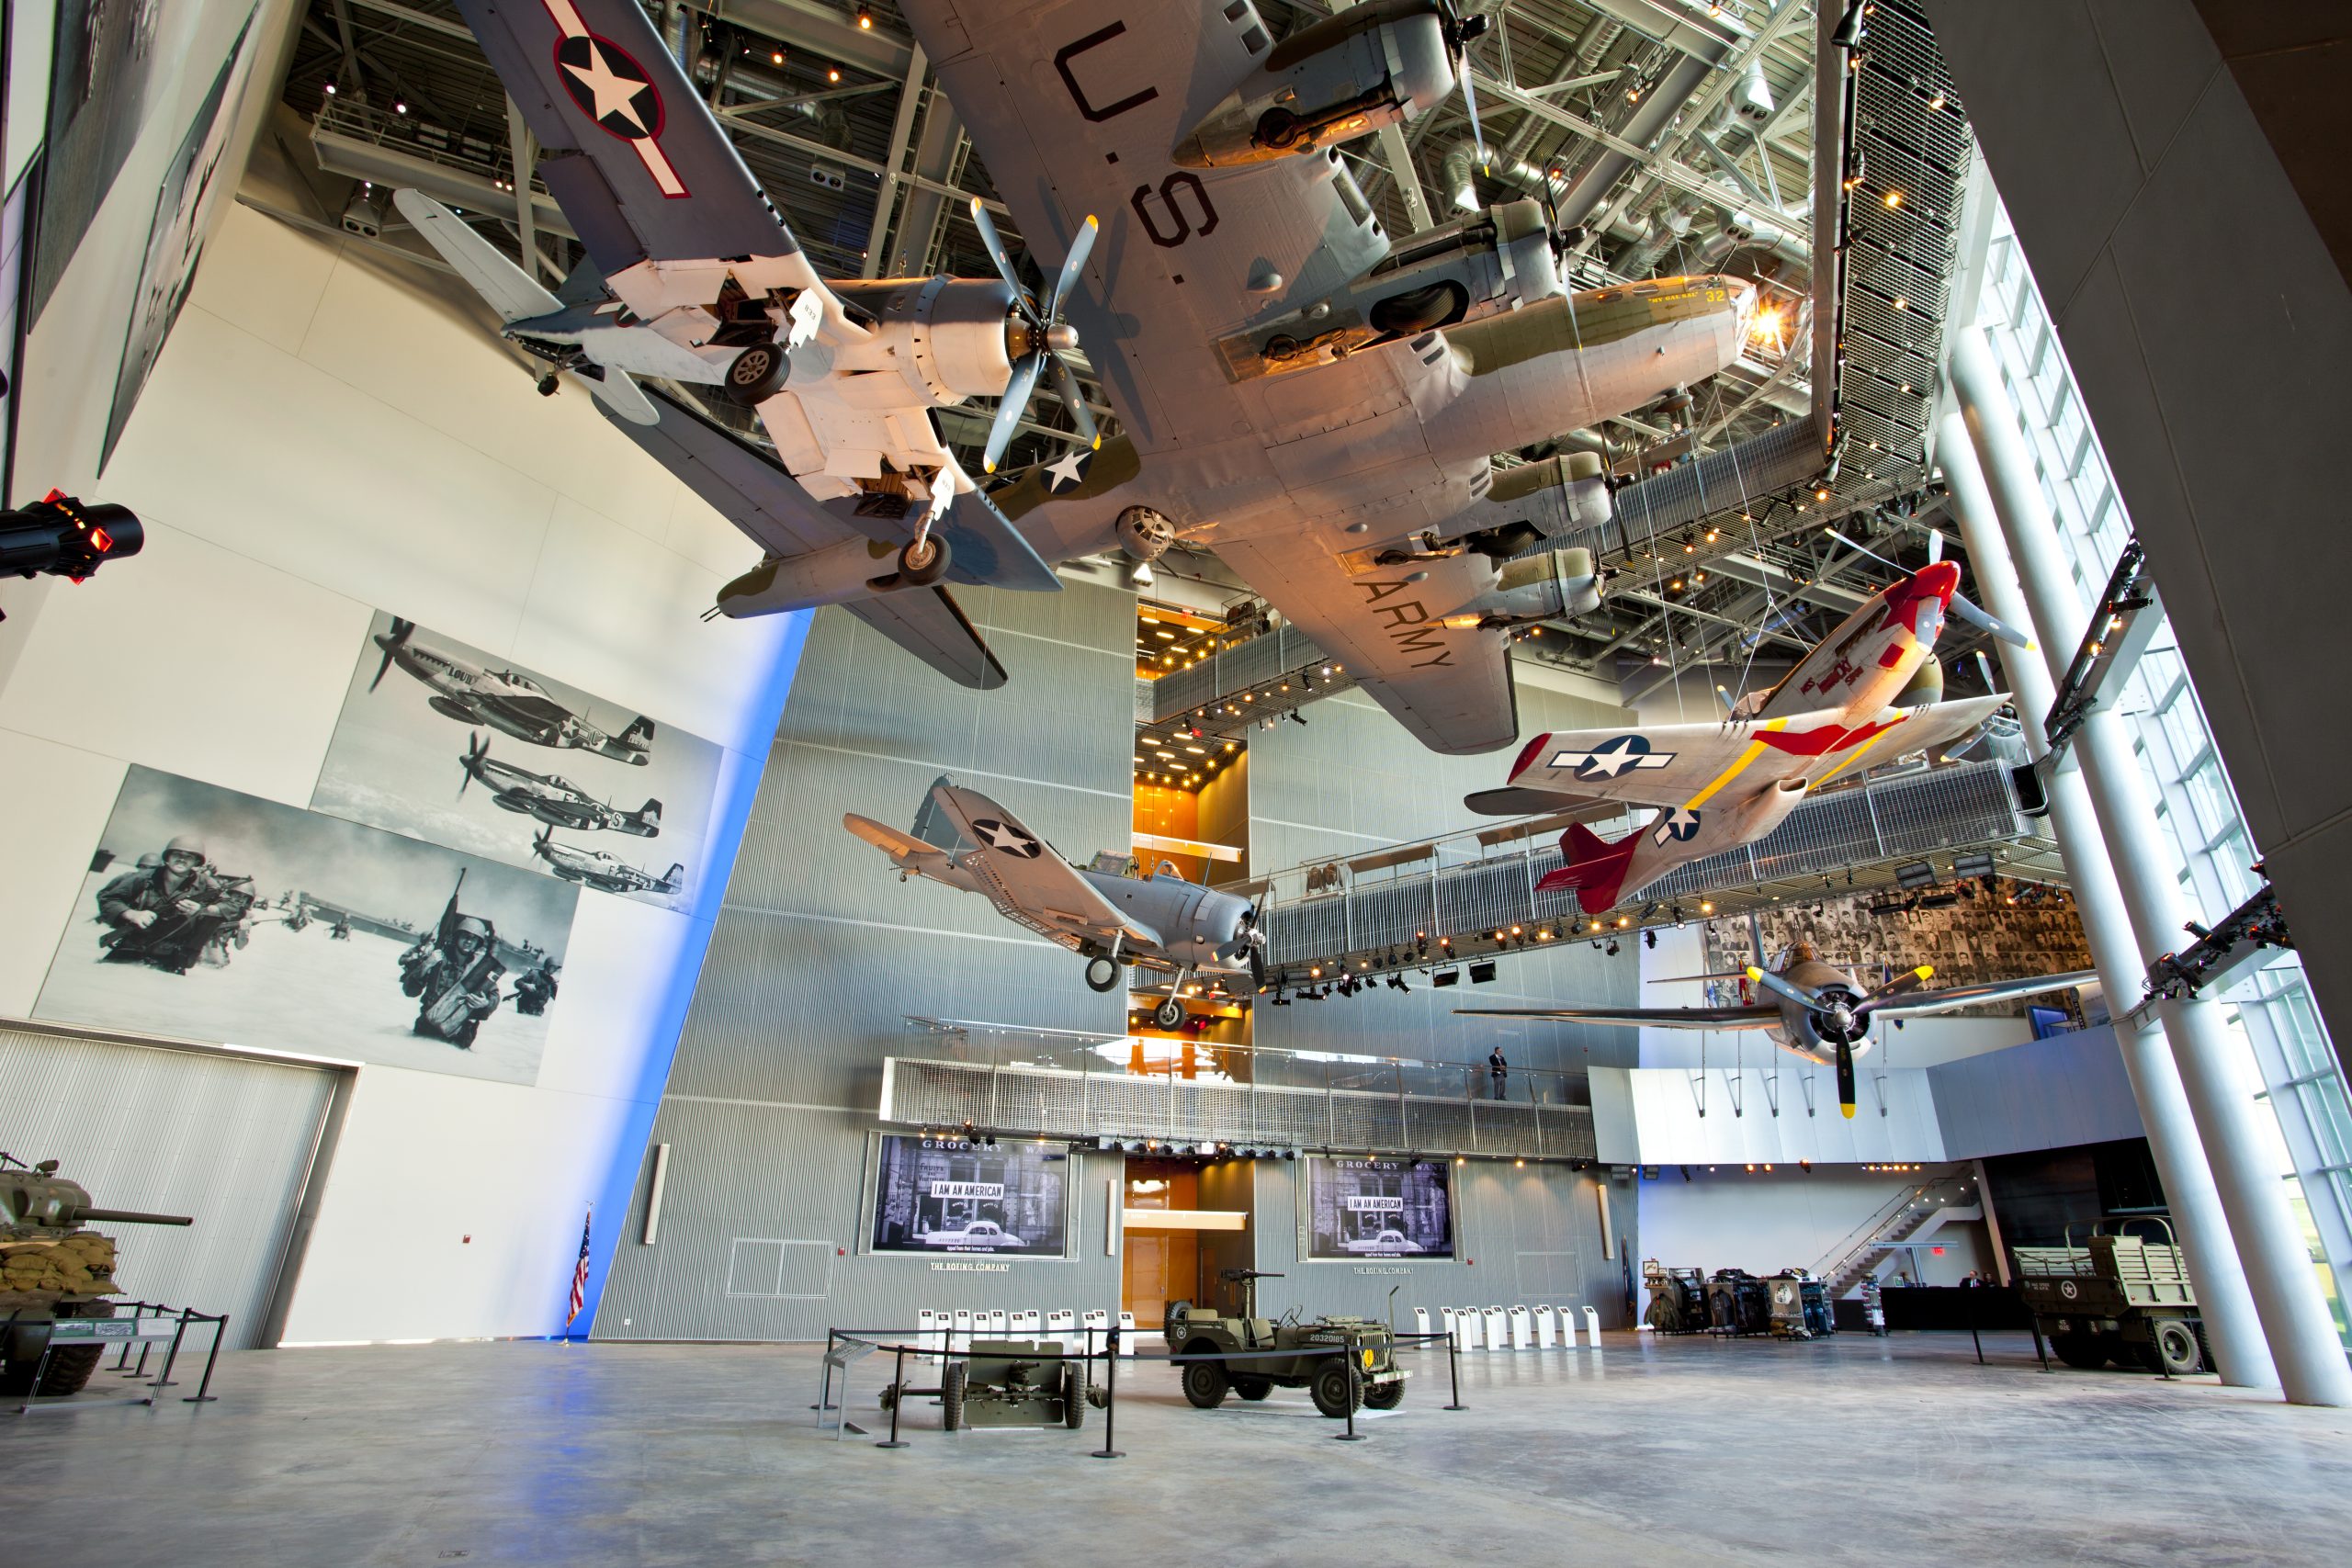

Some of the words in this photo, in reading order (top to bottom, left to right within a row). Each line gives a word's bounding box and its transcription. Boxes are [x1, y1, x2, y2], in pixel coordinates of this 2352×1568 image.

[1706, 289, 1725, 302] 32
[1353, 581, 1455, 668] ARMY
[922, 1140, 1005, 1153] GROCERY
[1336, 1160, 1400, 1170] GROCERY
[934, 1183, 937, 1195] I
[939, 1184, 950, 1195] AM
[953, 1184, 963, 1196] AN
[965, 1185, 1001, 1198] AMERICAN
[1350, 1198, 1352, 1208] I
[1353, 1199, 1362, 1208] AM
[1363, 1199, 1372, 1209] AN
[1373, 1199, 1401, 1209] AMERICAN
[931, 1262, 944, 1270] THE
[946, 1262, 974, 1271] BOEING
[975, 1263, 1010, 1272] COMPANY
[1353, 1267, 1366, 1275] THE
[1366, 1267, 1388, 1275] BOEING
[1388, 1267, 1414, 1275] COMPANY
[1310, 1334, 1345, 1343] 20320185
